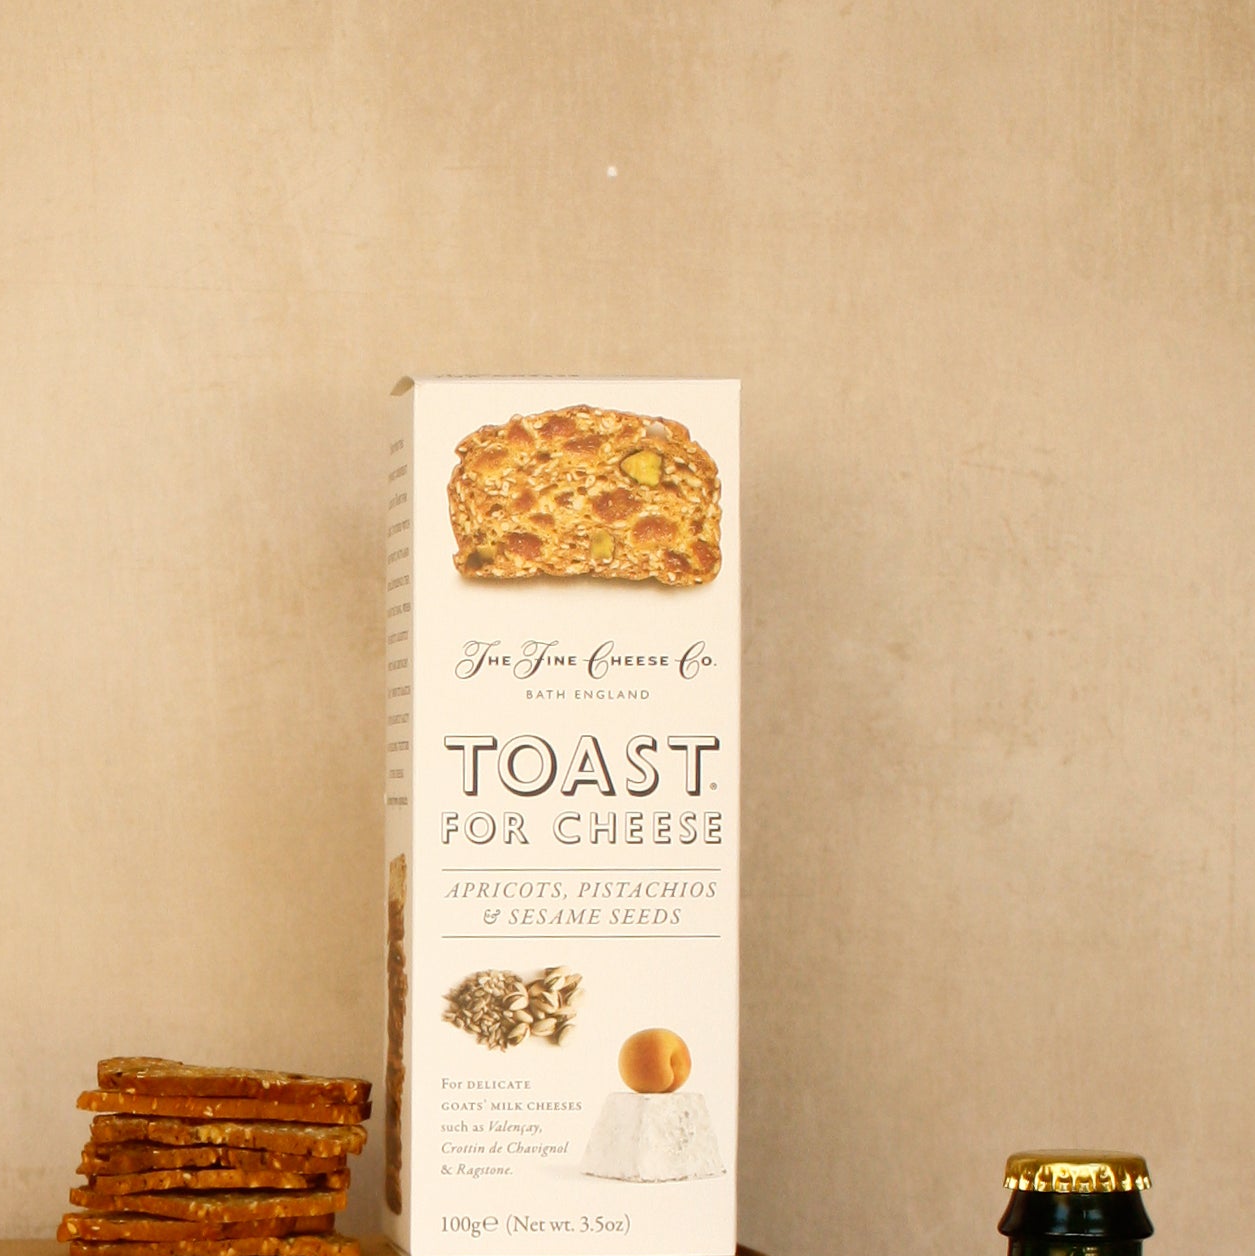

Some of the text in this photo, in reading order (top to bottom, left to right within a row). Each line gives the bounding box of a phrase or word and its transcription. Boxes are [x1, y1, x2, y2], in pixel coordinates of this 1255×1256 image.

[526, 689, 651, 700] BATH ENGLAND
[441, 811, 722, 845] FOR CHEESE
[444, 880, 717, 900] APRICOTS, PISTACHIOS
[482, 908, 682, 925] & SESAME SEEDS
[441, 1078, 531, 1090] For DELICATE
[491, 1101, 523, 1111] MILK
[527, 1101, 582, 1111] CHEESES
[441, 1120, 468, 1132] such
[472, 1124, 485, 1132] as
[441, 1141, 569, 1157] Crottin de Chavignol
[441, 1163, 513, 1179] & Ragstone.
[506, 1215, 545, 1236] (Net
[550, 1218, 575, 1232] wt.
[579, 1215, 631, 1236] 3.5oz)
